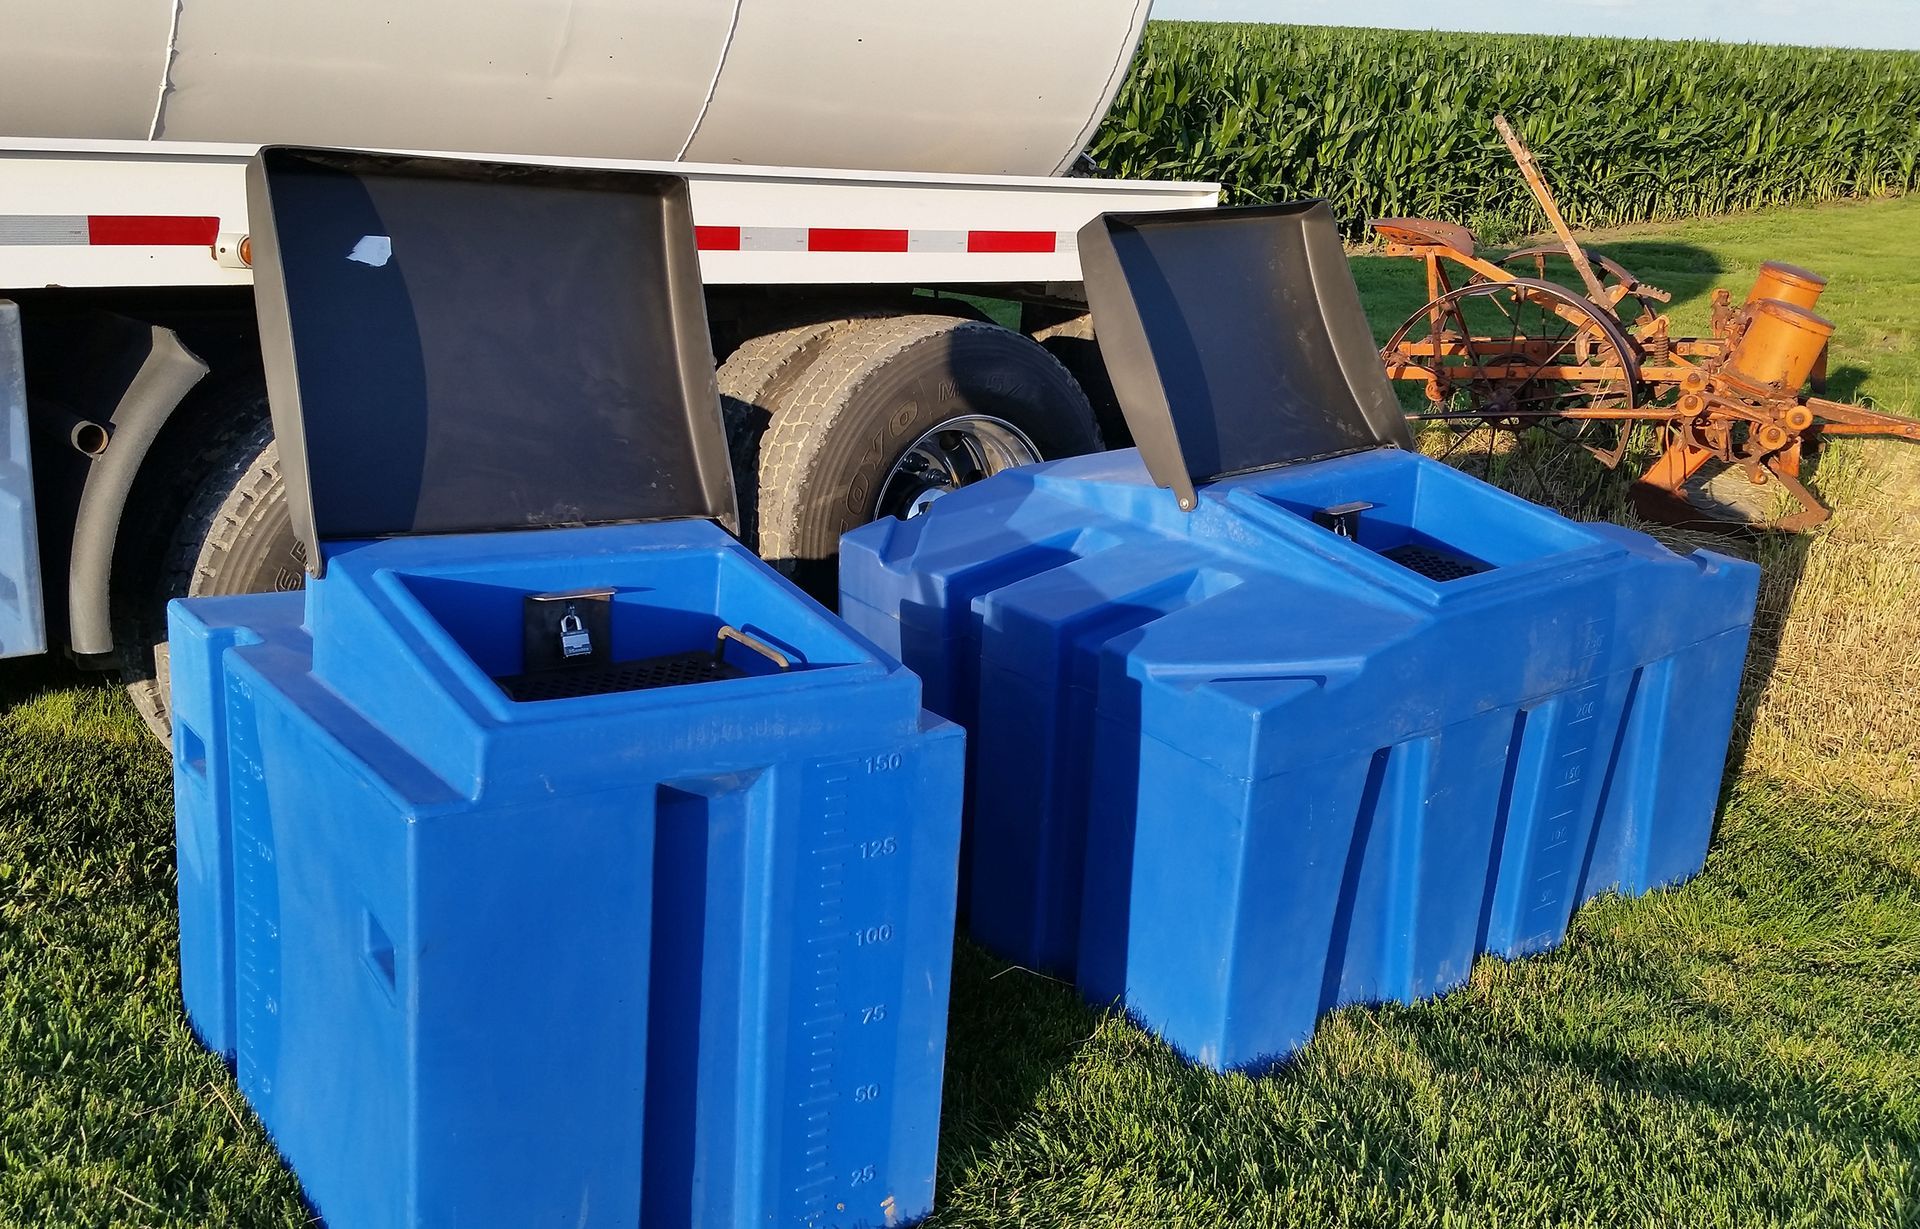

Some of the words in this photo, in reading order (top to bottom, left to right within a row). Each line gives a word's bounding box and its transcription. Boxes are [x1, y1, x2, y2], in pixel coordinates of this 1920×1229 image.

[865, 752, 903, 775] 150
[860, 836, 897, 859] 125
[855, 924, 892, 947] 100
[861, 1004, 887, 1025] 75
[854, 1083, 880, 1103] 50
[850, 1164, 877, 1188] 25
